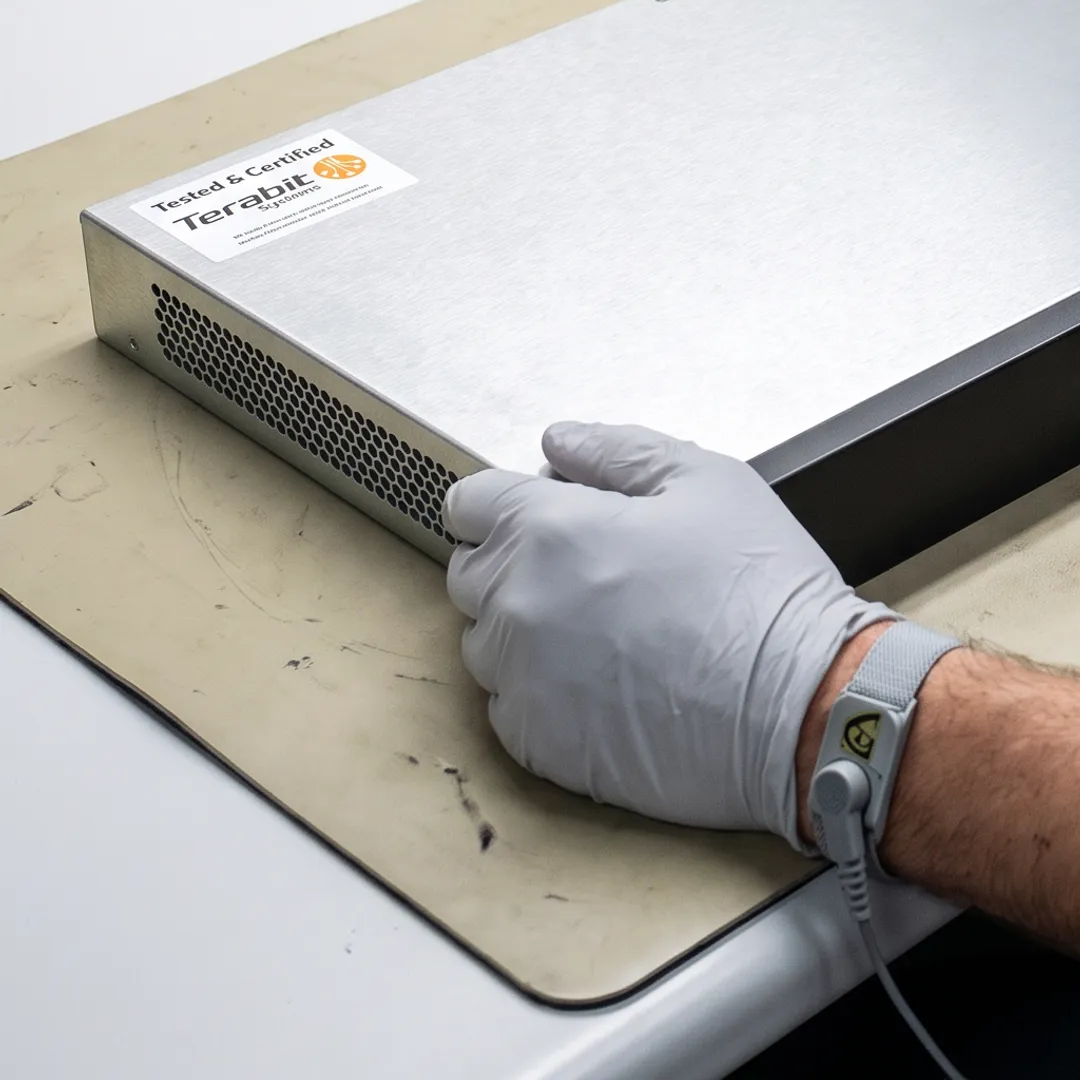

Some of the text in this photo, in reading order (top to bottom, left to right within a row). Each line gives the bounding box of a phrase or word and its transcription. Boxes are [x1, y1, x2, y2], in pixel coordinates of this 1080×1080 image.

[150, 180, 225, 213] Tested
[226, 174, 245, 185] &
[244, 138, 335, 177] Certified
[172, 173, 316, 231] Terabit
